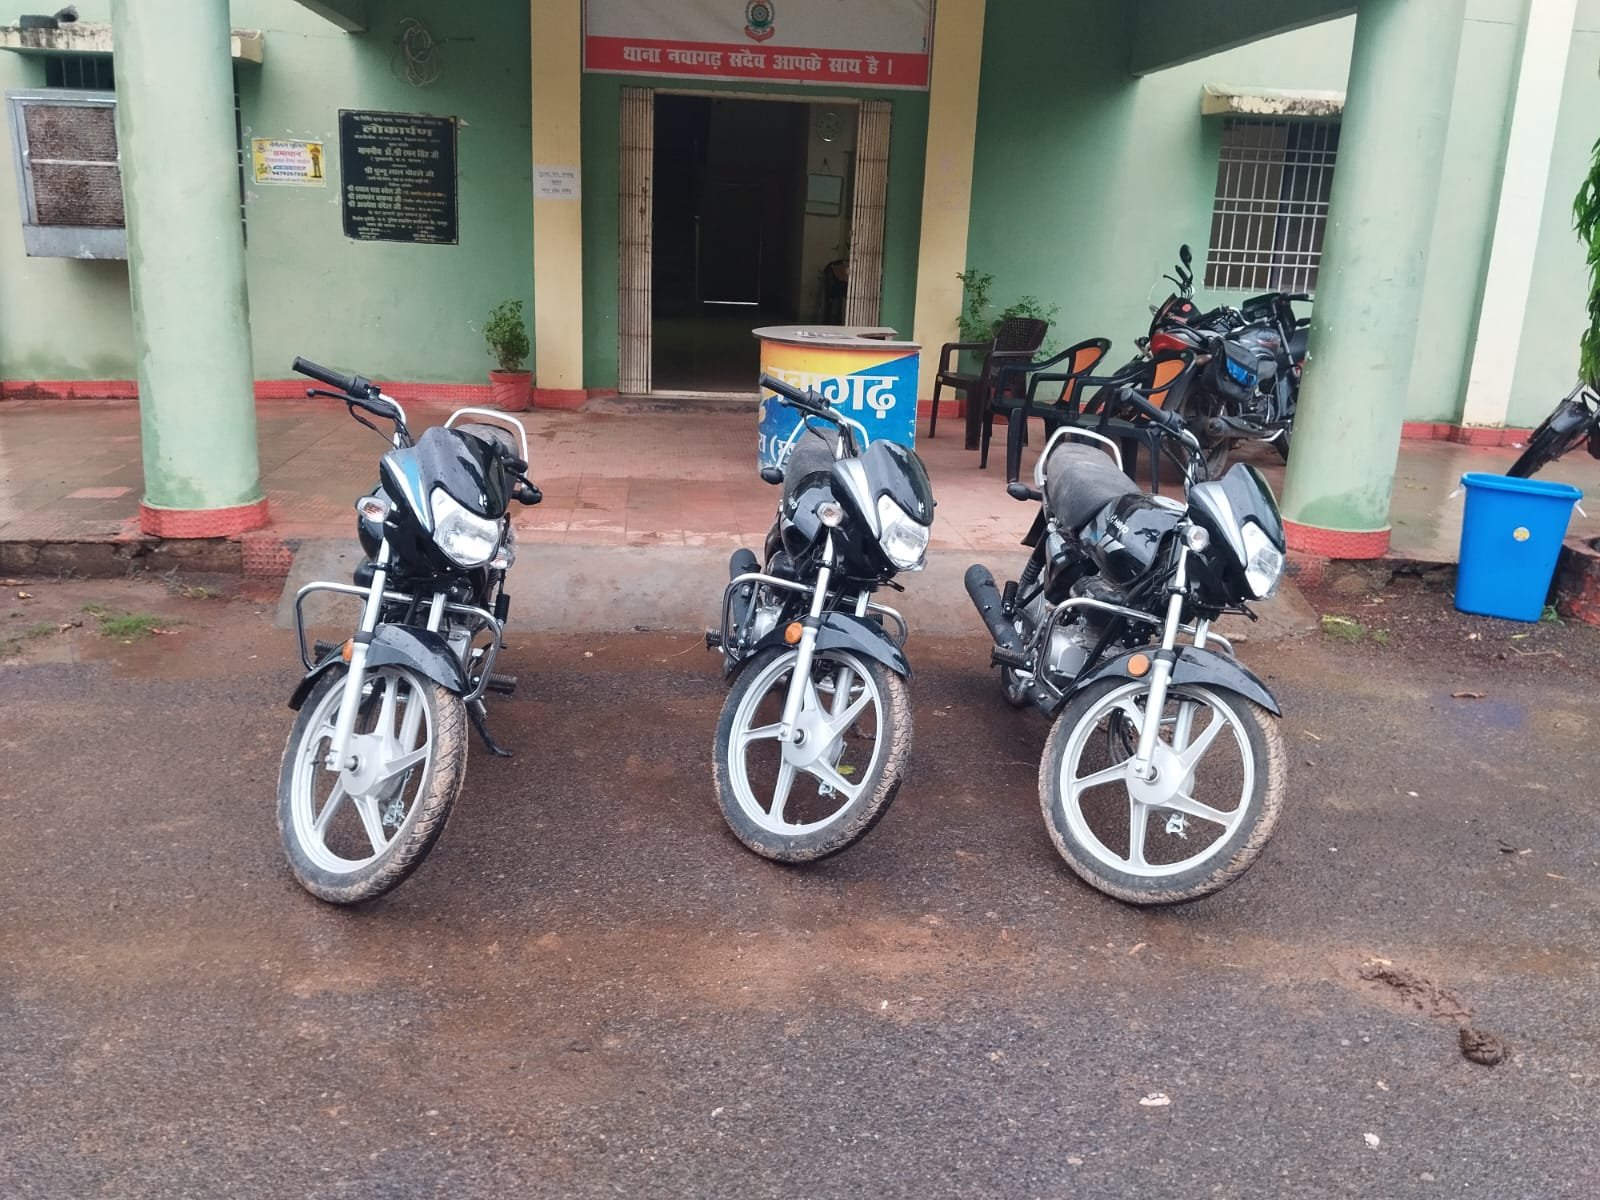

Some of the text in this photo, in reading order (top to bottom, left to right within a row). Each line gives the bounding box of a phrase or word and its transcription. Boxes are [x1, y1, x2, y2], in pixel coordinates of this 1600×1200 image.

[623, 46, 661, 62] थाना
[667, 48, 722, 70] नवागढ़
[728, 48, 766, 69] सदैव
[773, 51, 823, 71] आपके
[828, 56, 862, 74] साथ
[865, 55, 879, 75] है
